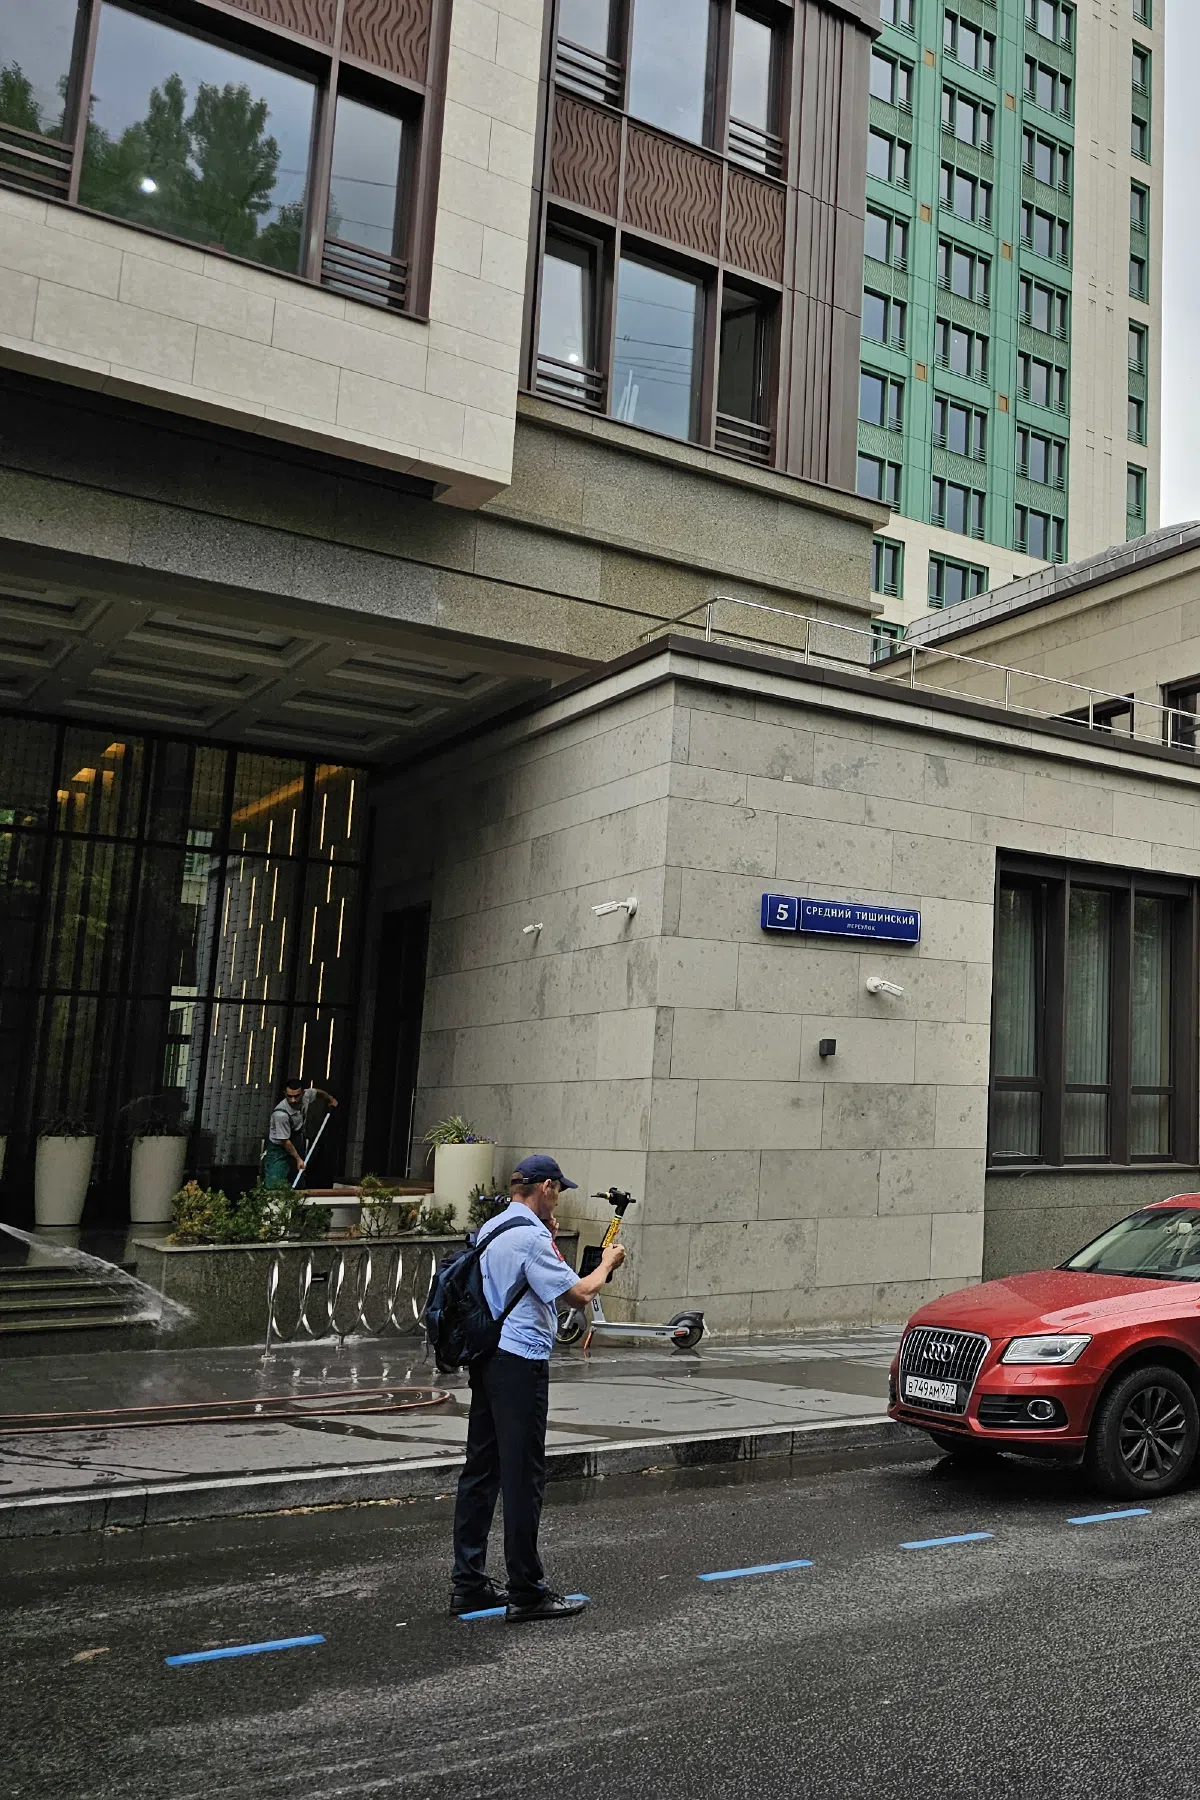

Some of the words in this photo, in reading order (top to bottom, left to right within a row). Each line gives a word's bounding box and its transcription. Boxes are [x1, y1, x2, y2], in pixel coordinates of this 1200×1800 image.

[776, 903, 789, 921] 5
[806, 905, 852, 919] СРЕДНИЙ
[855, 911, 915, 926] ТИШИНСКИЙ
[846, 923, 876, 931] ПЕРЕУЛОК
